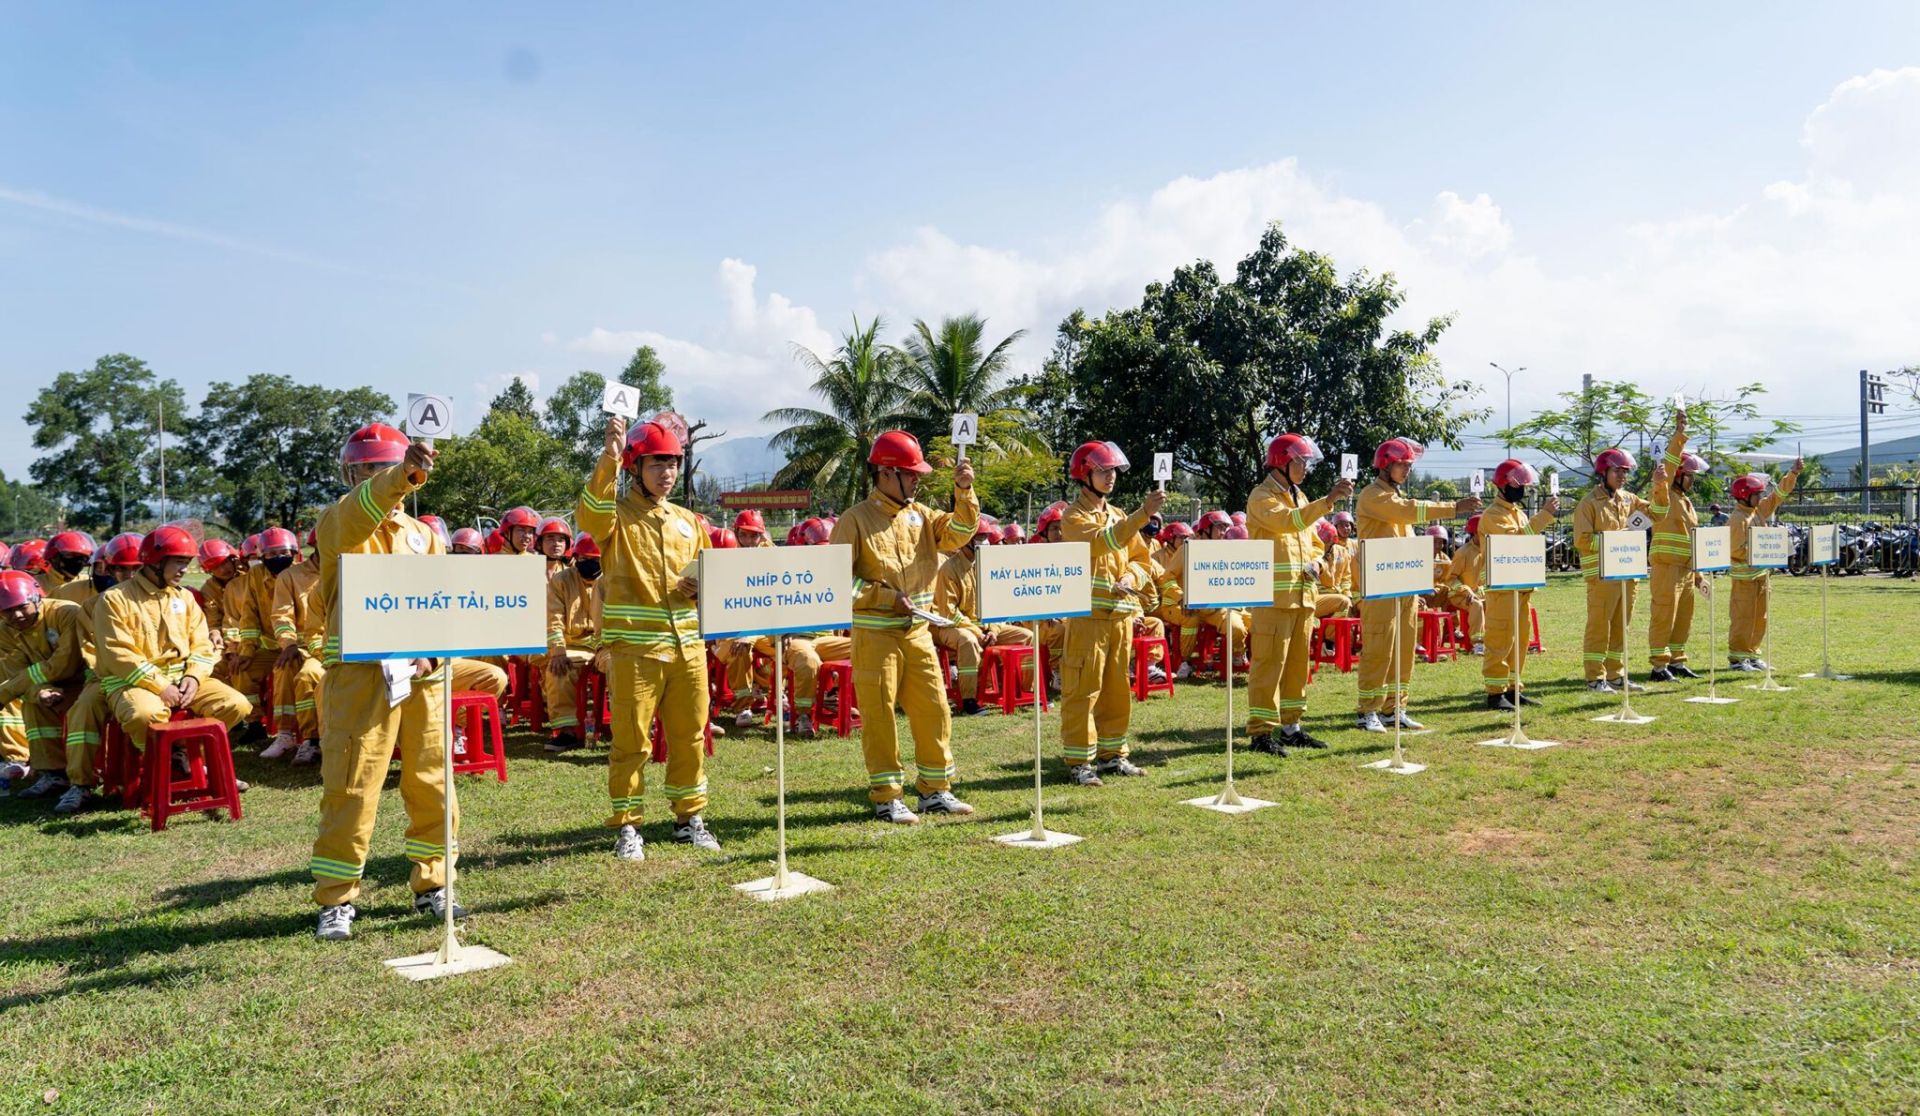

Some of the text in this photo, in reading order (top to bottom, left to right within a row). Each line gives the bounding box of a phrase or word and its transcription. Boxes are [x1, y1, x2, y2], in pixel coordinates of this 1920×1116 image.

[612, 390, 629, 408] A
[418, 403, 441, 427] A
[957, 419, 970, 436] A
[1654, 445, 1662, 455] A
[1158, 458, 1168, 474] A
[1345, 459, 1354, 473] A
[1473, 475, 1481, 487] A
[1631, 515, 1643, 527] B
[990, 564, 1083, 581] MÁY LẠNH TẢI, BUS
[1193, 560, 1269, 572] LINH KIỆN COMPOSITE
[1376, 562, 1385, 571] SƠ
[1386, 562, 1394, 570] MI
[746, 570, 814, 587] NHÍP Ô TÔ
[1208, 577, 1256, 586] KEO & DDCD
[724, 587, 834, 610] KHUNG THÂN VỎ
[1013, 585, 1062, 597] GĂNG TAY
[365, 590, 528, 613] NỘI THẤT TẢI, BUS
